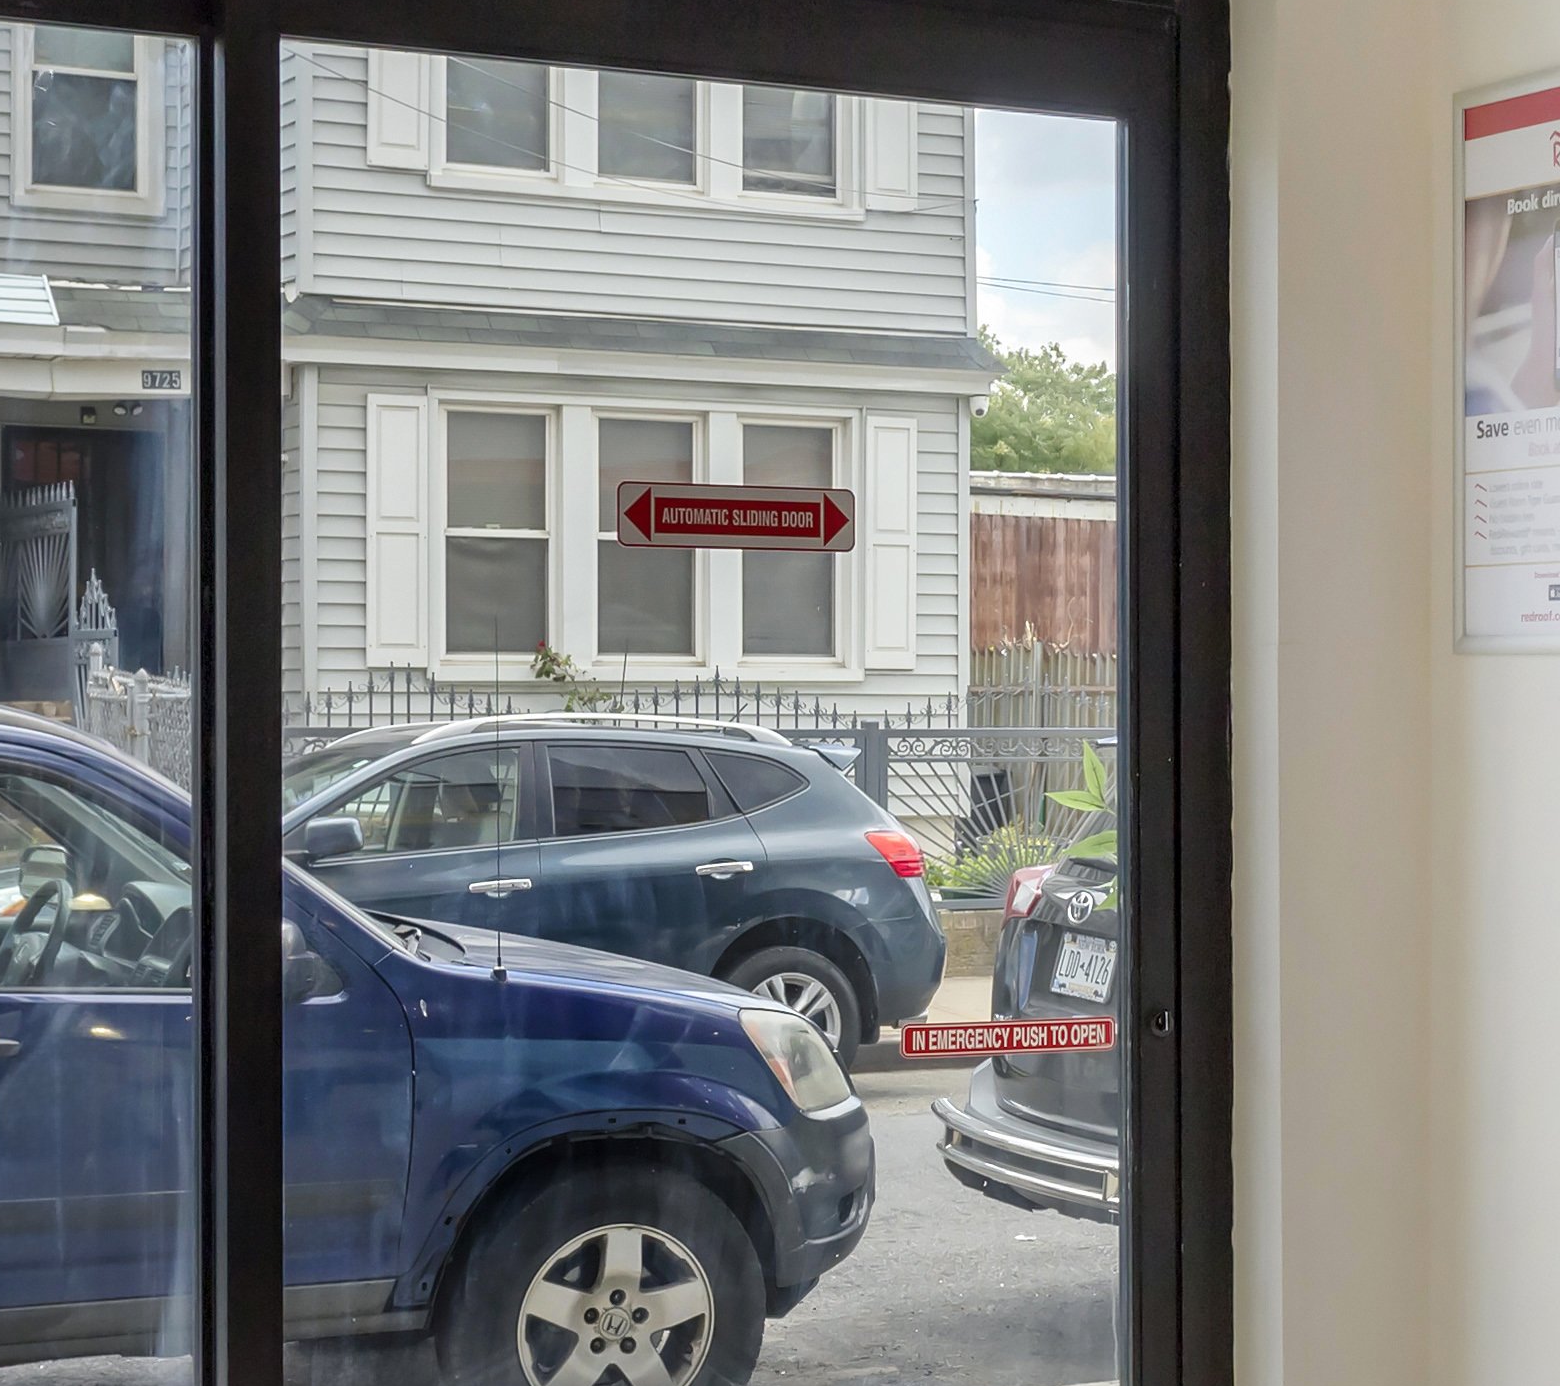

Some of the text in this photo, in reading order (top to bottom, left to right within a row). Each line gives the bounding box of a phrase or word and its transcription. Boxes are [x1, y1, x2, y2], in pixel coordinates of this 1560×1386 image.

[1507, 196, 1538, 215] Book
[143, 372, 180, 388] 9725
[1476, 420, 1509, 439] Save
[1513, 419, 1539, 436] even
[662, 507, 814, 528] AUTOMATIC SLIDING DOOR
[1084, 954, 1112, 986] 4126
[912, 1023, 1106, 1051] IN EMERGENCY PUSH TO OPEN
